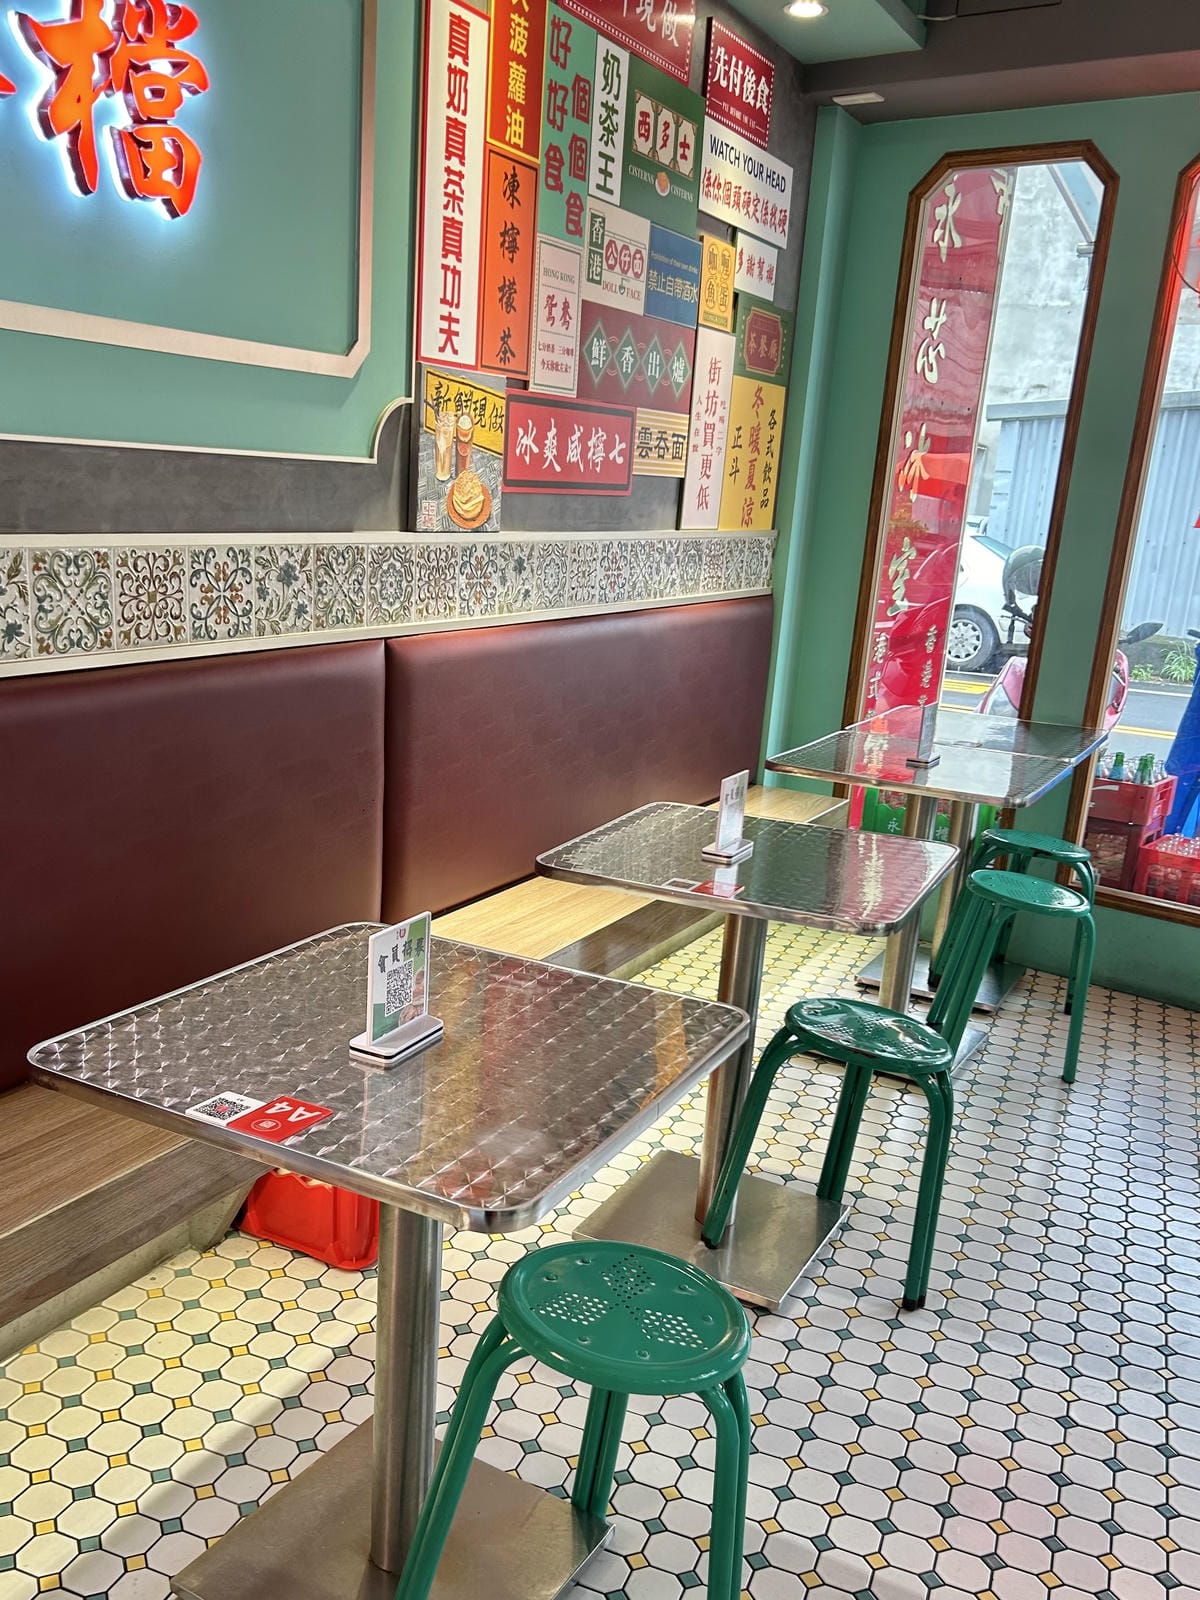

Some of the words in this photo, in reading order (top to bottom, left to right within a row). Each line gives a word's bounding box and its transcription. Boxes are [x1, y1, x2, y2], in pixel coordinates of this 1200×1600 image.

[505, 0, 529, 148] 菠蘿油
[713, 45, 769, 115] 先付後食
[0, 0, 209, 217] 檔
[596, 48, 621, 196] 奶茶王
[638, 110, 690, 161] 西多士
[438, 11, 470, 356] 真奶真茶真功夫
[629, 164, 655, 185] CISTERNS
[710, 134, 740, 168] WATCH
[743, 153, 763, 182] YOUR
[766, 167, 786, 193] HEAD
[496, 165, 521, 366] 凍檸檬茶
[543, 267, 559, 279] HONG
[560, 271, 575, 285] KONG
[589, 217, 604, 281] 香港
[606, 240, 643, 275] 公仔面
[544, 294, 573, 331] 鴛鴦
[602, 280, 618, 294] DOLL
[626, 287, 641, 301] FACE
[648, 269, 698, 302] 禁止自帶酒水
[590, 337, 685, 384] 鮮香出爐
[431, 381, 504, 433] 新鮮現做
[697, 356, 722, 511] 街坊買更低
[516, 418, 627, 473] 冰爽咸檸七
[637, 426, 687, 461] 雲吞面
[729, 426, 743, 485] 正斗
[741, 384, 764, 528] 冬暖夏涼
[760, 408, 777, 509] 各式飲品
[264, 1101, 322, 1123] A4
